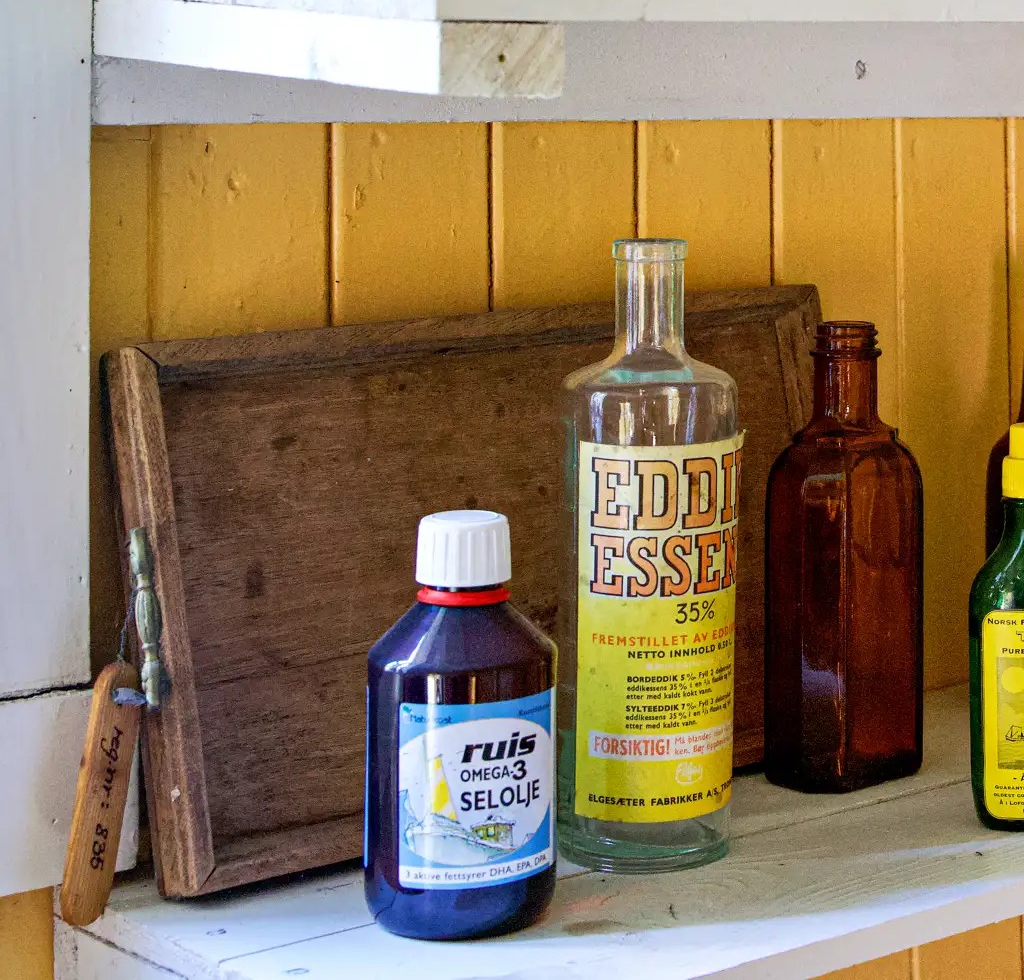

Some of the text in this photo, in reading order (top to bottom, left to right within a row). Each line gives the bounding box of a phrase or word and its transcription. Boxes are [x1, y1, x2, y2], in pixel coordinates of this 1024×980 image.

[676, 598, 715, 625] 35%
[592, 632, 708, 647] FREMSTILLET AV
[627, 644, 716, 659] NETTO INNHOLD
[627, 675, 678, 683] BORDEDDIK
[626, 683, 679, 692] eddikessens 35
[626, 689, 698, 701] etter med kaldt kokt
[625, 704, 679, 713] SYLTEEDDIK
[669, 712, 678, 720] 35
[625, 720, 680, 730] etter med kaldt
[461, 731, 537, 763] ruis
[593, 735, 670, 757] FORSIKTIG!
[460, 760, 527, 783] OMEGA-3
[460, 778, 540, 812] SELOLJE
[588, 792, 703, 808] ELGESÆTER FABRIKKER
[90, 823, 109, 871] 835
[444, 869, 486, 881] fettsyrer
